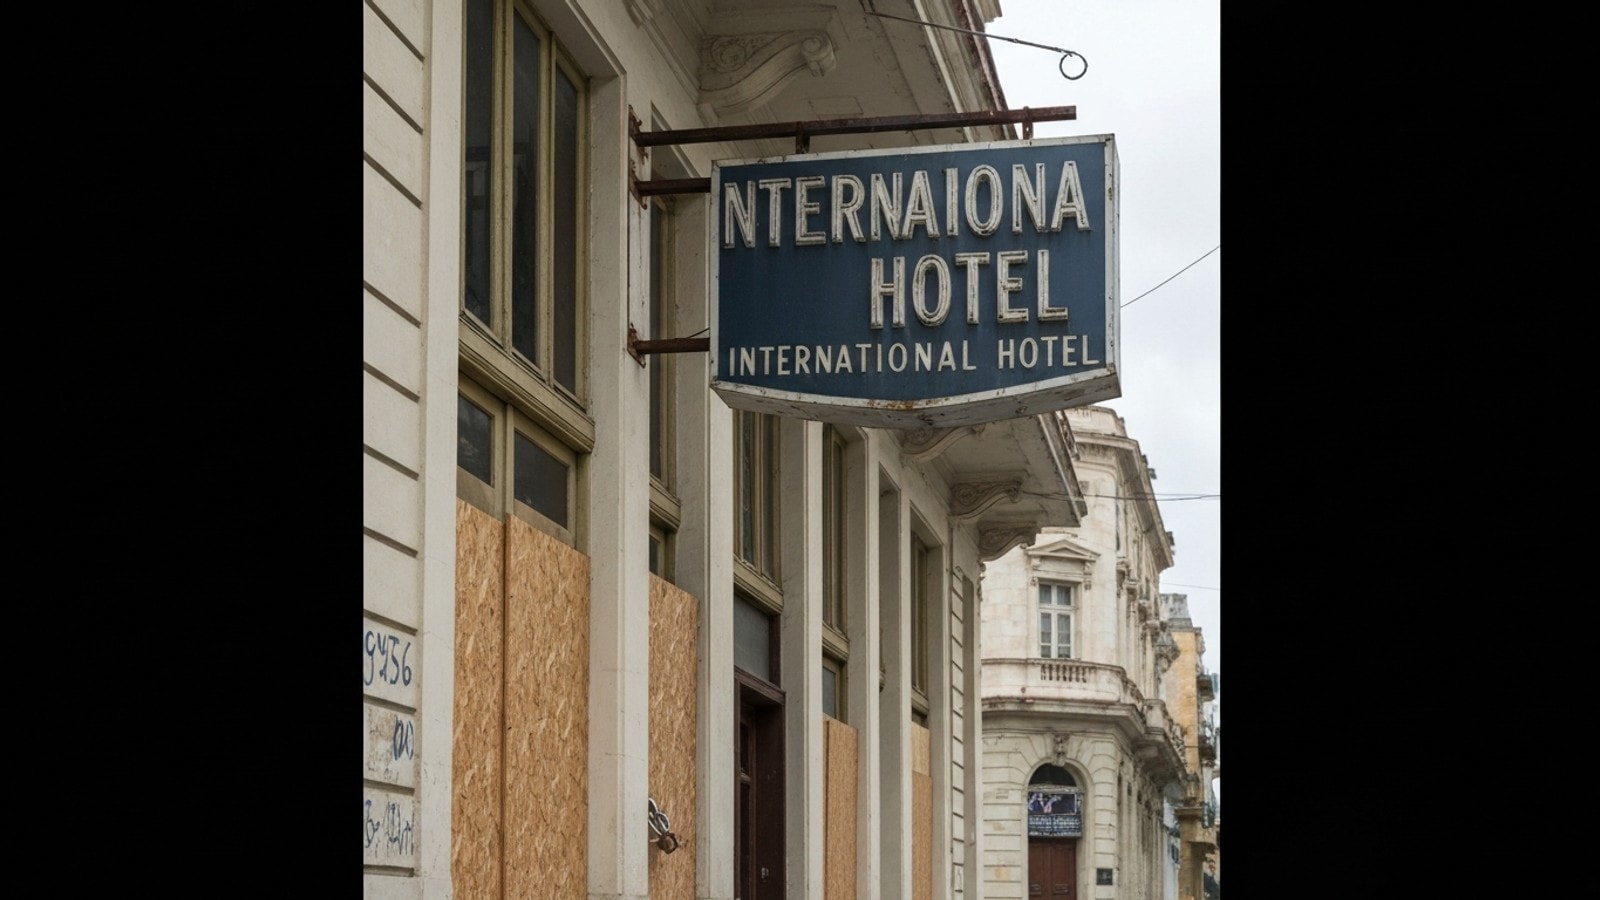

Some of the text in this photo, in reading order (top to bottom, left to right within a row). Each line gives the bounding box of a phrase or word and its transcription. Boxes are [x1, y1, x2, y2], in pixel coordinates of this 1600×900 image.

[723, 160, 1092, 249] NTERNAIONA
[870, 249, 1069, 330] HOTEL
[729, 335, 1100, 377] INTERNATIONAL HOTEL
